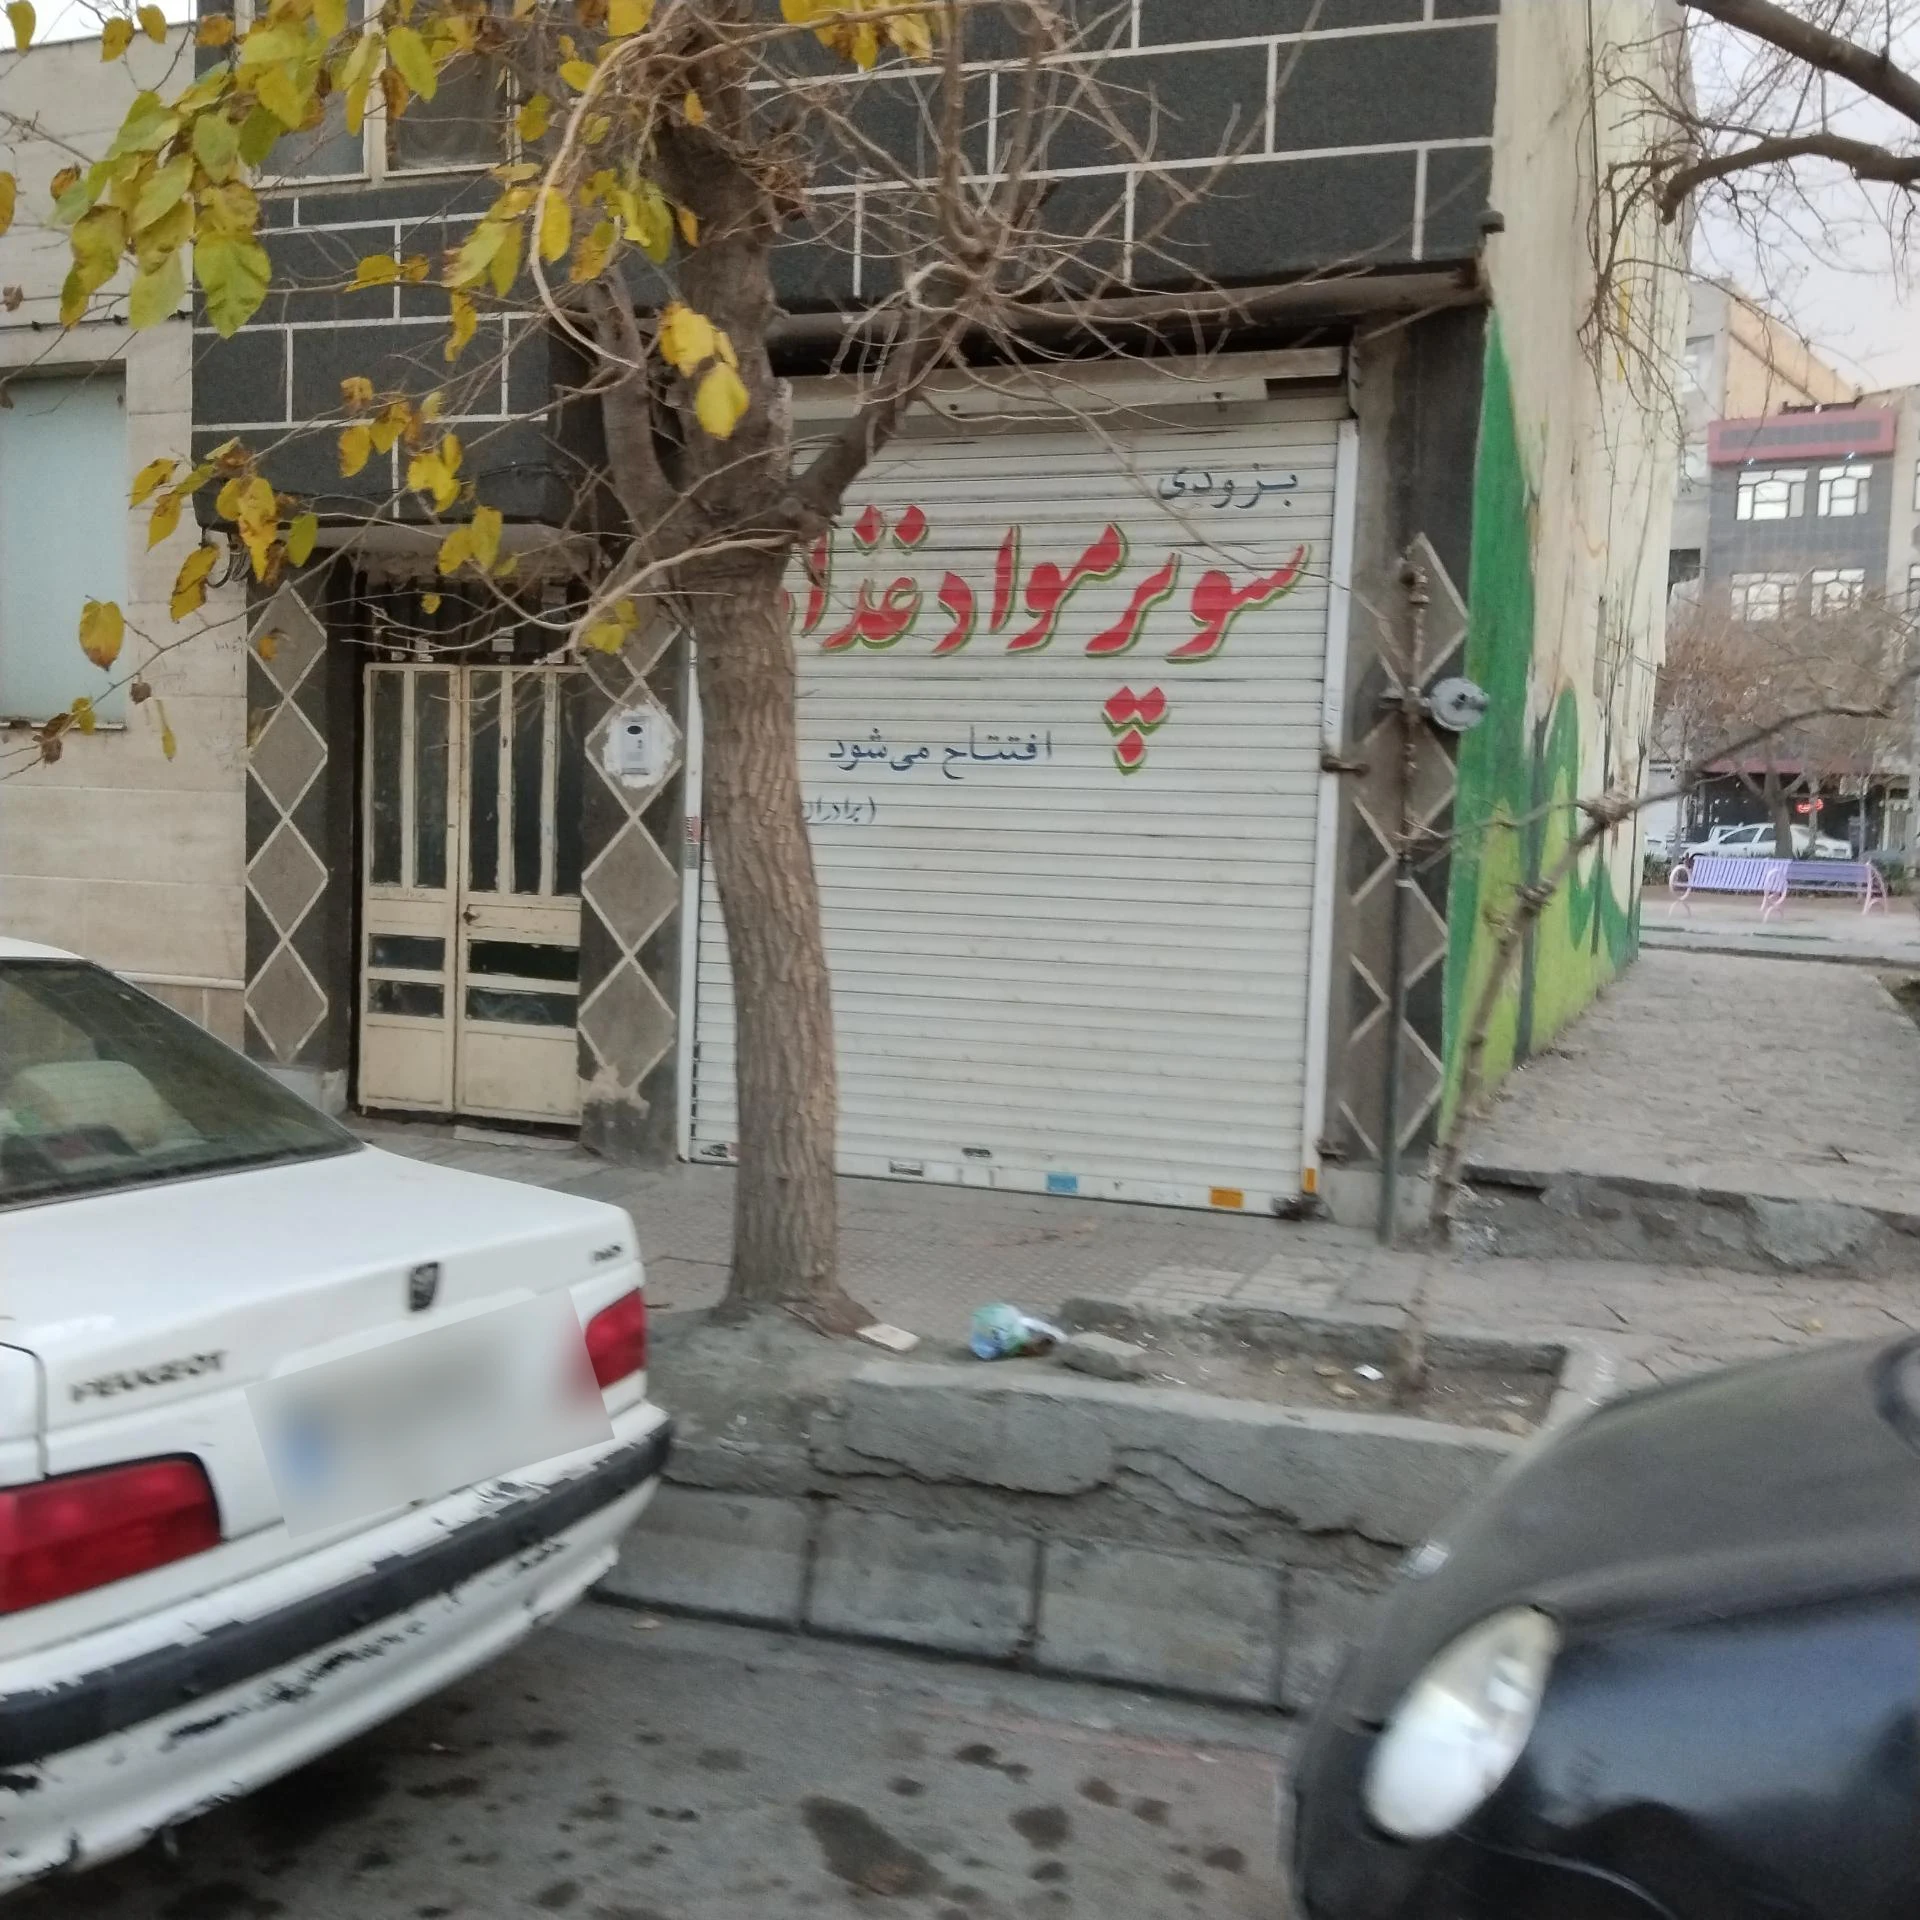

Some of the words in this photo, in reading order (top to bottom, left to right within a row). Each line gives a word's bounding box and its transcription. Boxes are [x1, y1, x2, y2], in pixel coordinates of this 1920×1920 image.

[1157, 463, 1297, 508] بزودی
[931, 522, 1129, 658] مواد
[943, 726, 1051, 780] افتتاح
[71, 1350, 225, 1403] PEUGEOT
